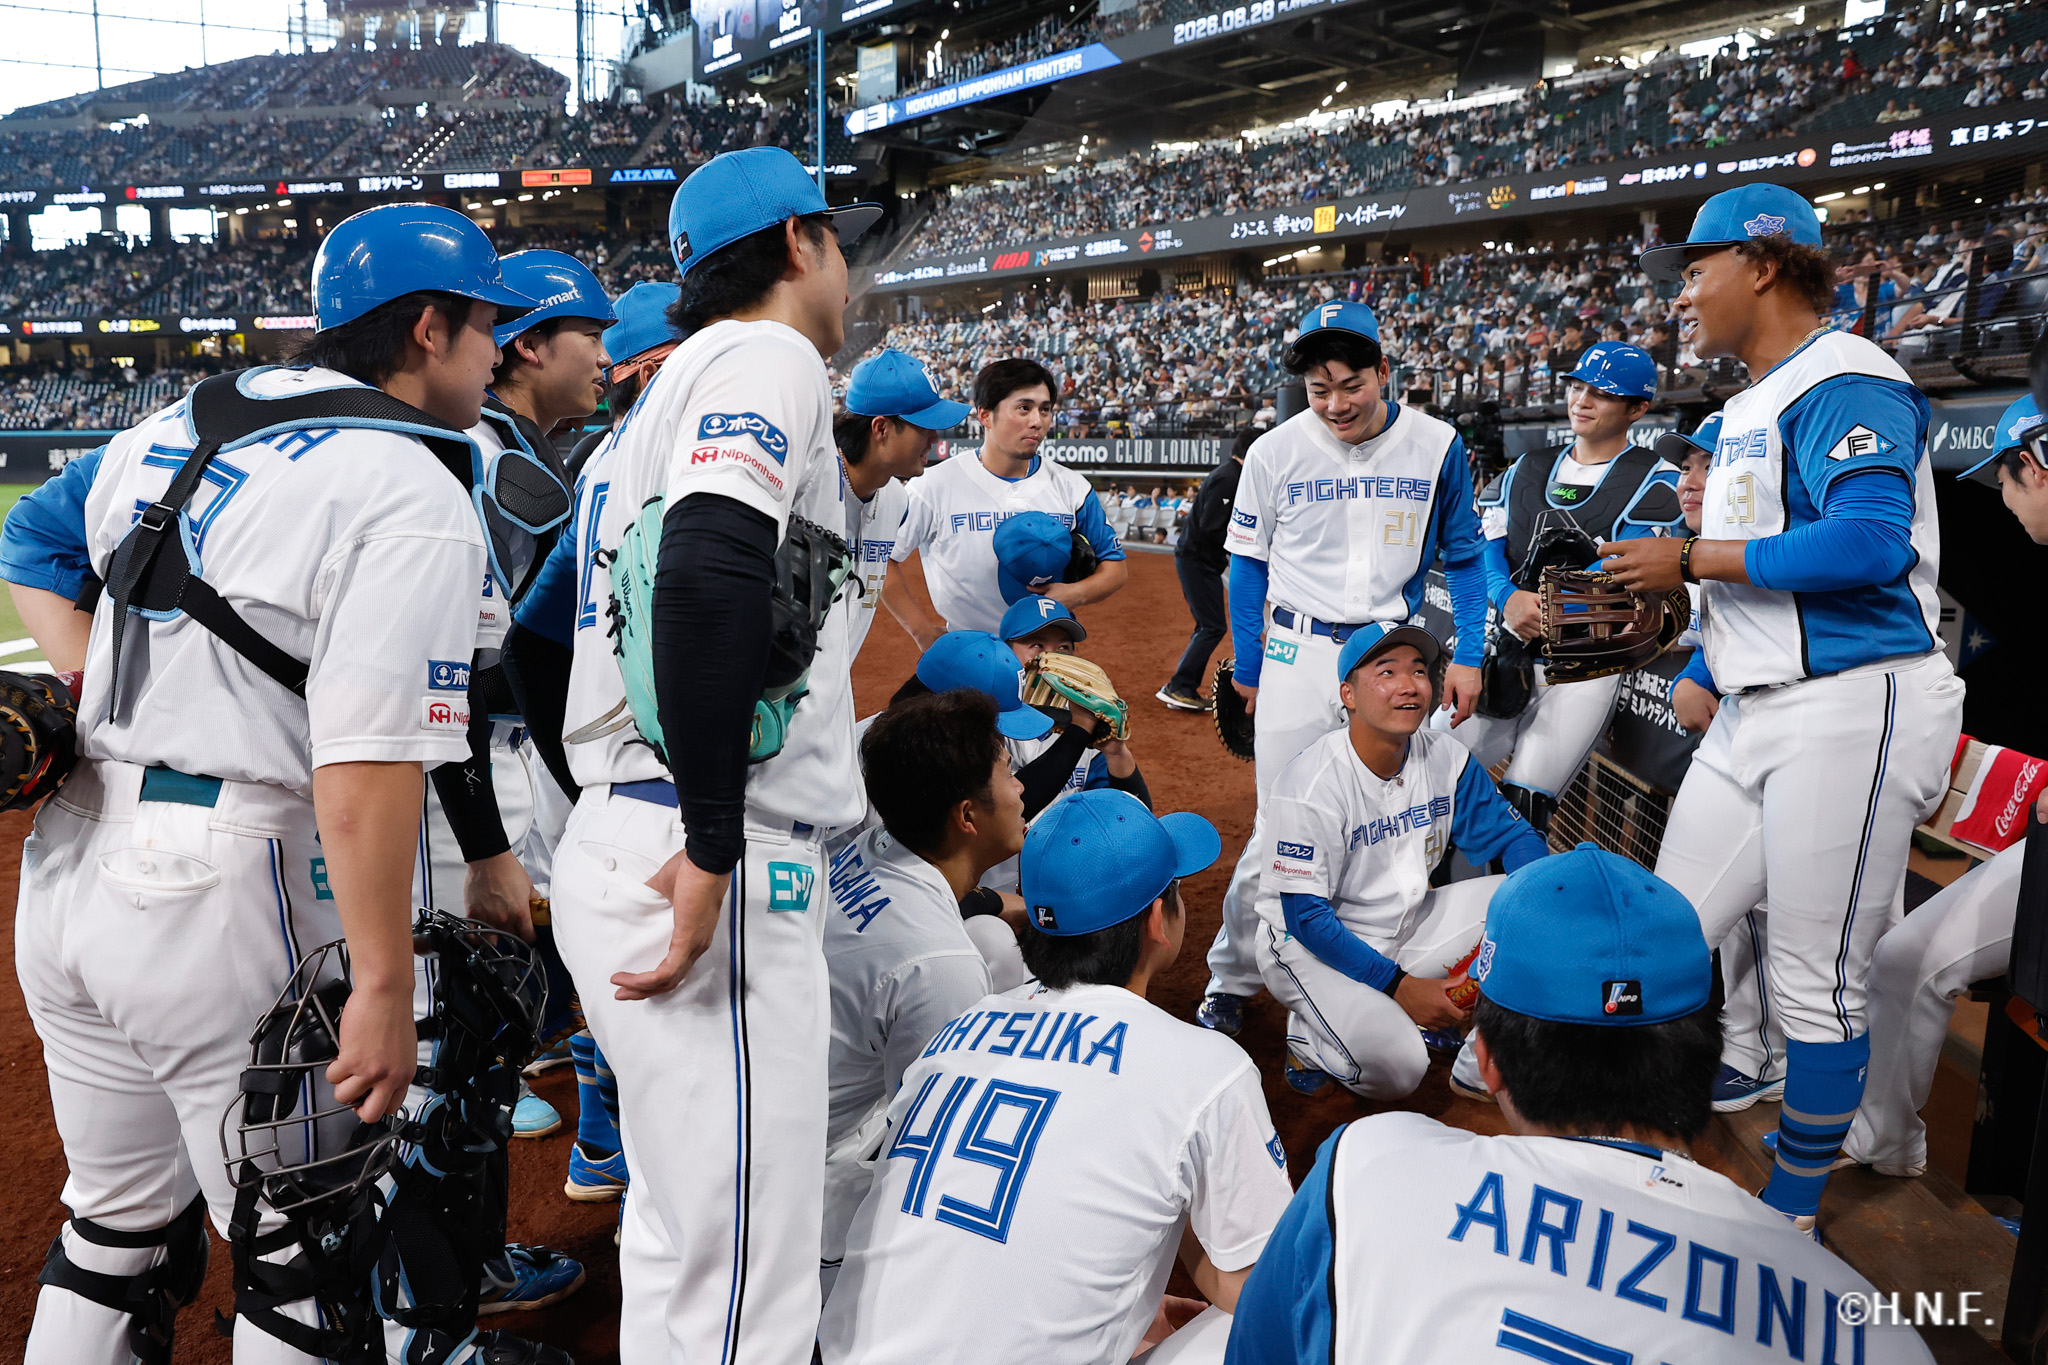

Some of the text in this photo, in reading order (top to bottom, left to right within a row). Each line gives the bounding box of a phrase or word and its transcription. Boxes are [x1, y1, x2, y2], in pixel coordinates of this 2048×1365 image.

[1173, 0, 1275, 45] 2026.08.28
[905, 53, 1082, 116] HOKKAIDO NIPPONHAM FIGHTERS
[1949, 119, 2048, 147] 東日本フー
[609, 168, 678, 182] AIZAWA
[1640, 164, 1691, 185] 日本ルナ
[992, 251, 1030, 271] HBA
[1319, 303, 1343, 328] F
[1585, 348, 1607, 367] F
[728, 416, 789, 453] ホクレン
[1847, 433, 1873, 457] F
[1949, 425, 1996, 450] SMBC
[1037, 439, 1221, 465] docomo CLUB LOUNGE
[721, 448, 784, 491] Nipponham
[1287, 476, 1431, 505] FIGHTERS
[1383, 509, 1416, 547] 21
[621, 568, 633, 620] Wilson
[1037, 598, 1056, 619] F
[1266, 641, 1295, 660] ニトリ
[1995, 758, 2038, 838] Coca-Cola
[1350, 795, 1450, 851] FIGHTERS
[1281, 866, 1312, 877] Nipponham
[775, 870, 813, 903] ニトリ
[829, 844, 892, 933] AGAWA
[1618, 994, 1638, 1003] NPB
[922, 1011, 1129, 1075] OHTSUKA
[886, 1072, 1062, 1245] 49
[1660, 1176, 1683, 1188] NPB
